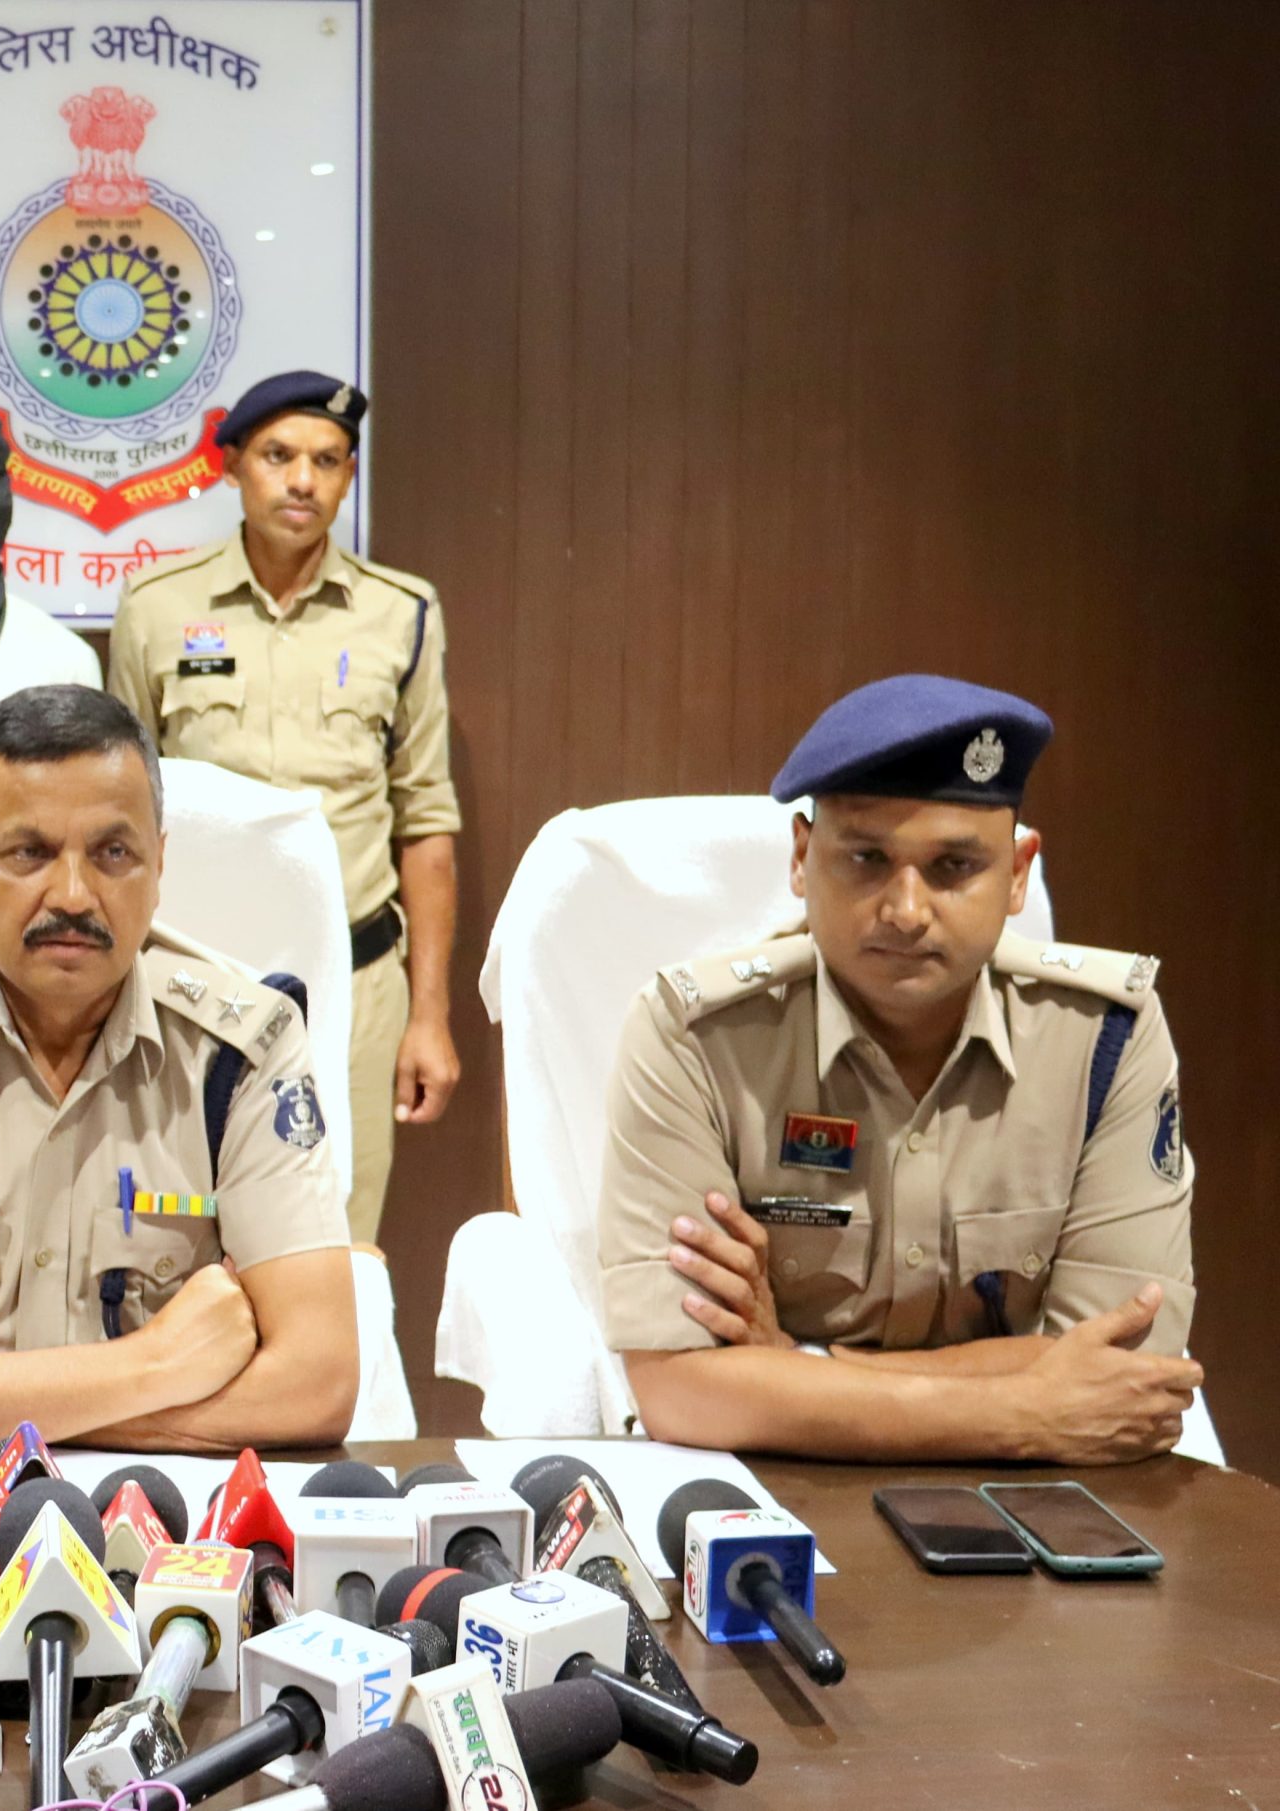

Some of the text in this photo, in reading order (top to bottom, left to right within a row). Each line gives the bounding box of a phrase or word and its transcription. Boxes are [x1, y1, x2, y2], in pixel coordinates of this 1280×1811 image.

[91, 16, 260, 91] अधीक्षक
[126, 432, 189, 467] पुलिस
[157, 1554, 232, 1577] 24
